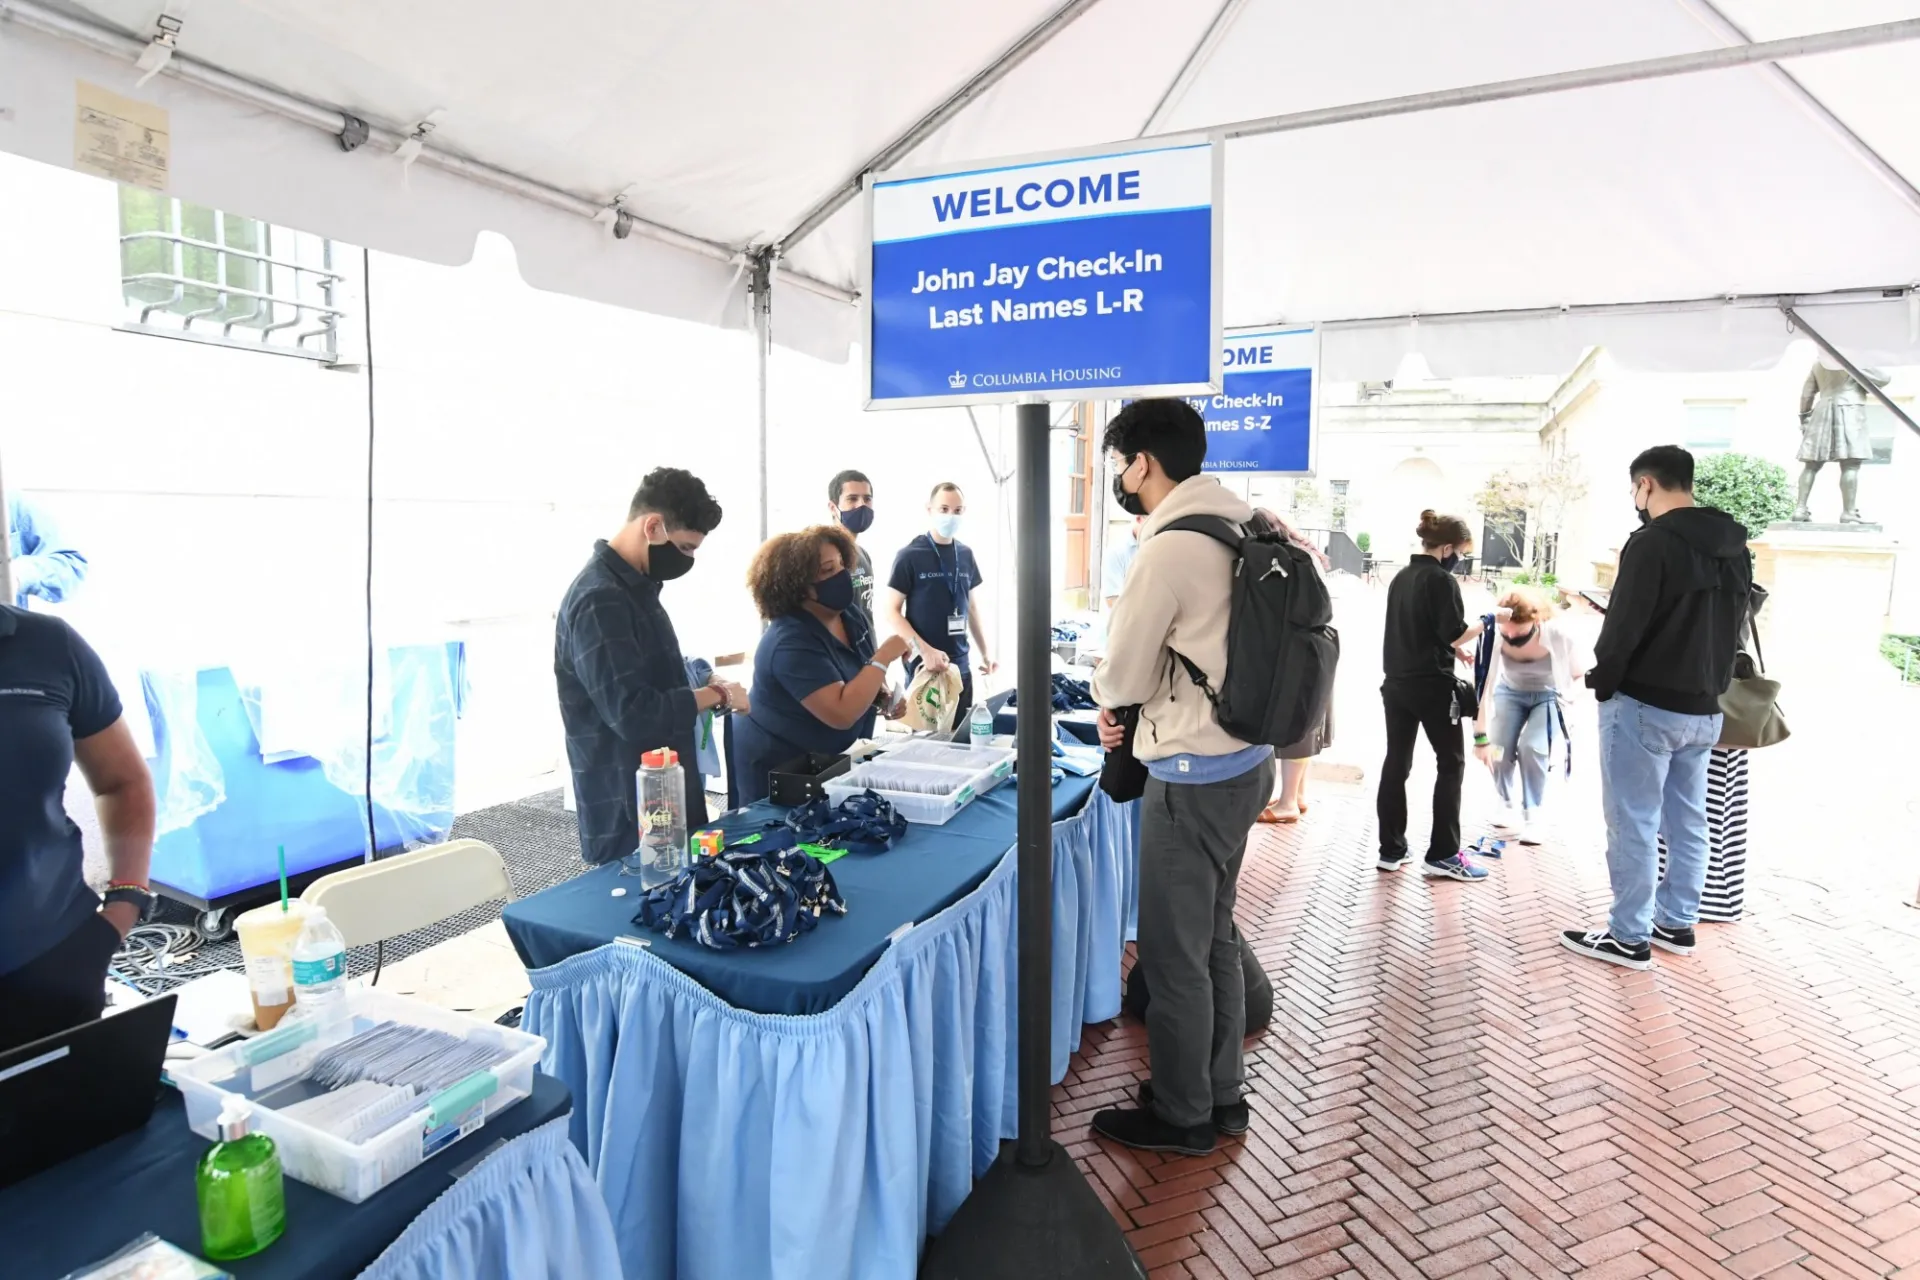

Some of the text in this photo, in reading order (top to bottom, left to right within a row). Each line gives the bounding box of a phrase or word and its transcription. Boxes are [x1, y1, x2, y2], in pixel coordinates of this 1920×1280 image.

[932, 170, 1140, 223] WELCOME
[911, 249, 1163, 294] John Jay Check-In
[929, 288, 1144, 329] Last Names L-R
[972, 366, 1122, 387] COLUMBIA HOUSING
[1211, 392, 1283, 409] Check-In
[1243, 415, 1272, 431] S-Z
[1219, 460, 1259, 469] HOUSING
